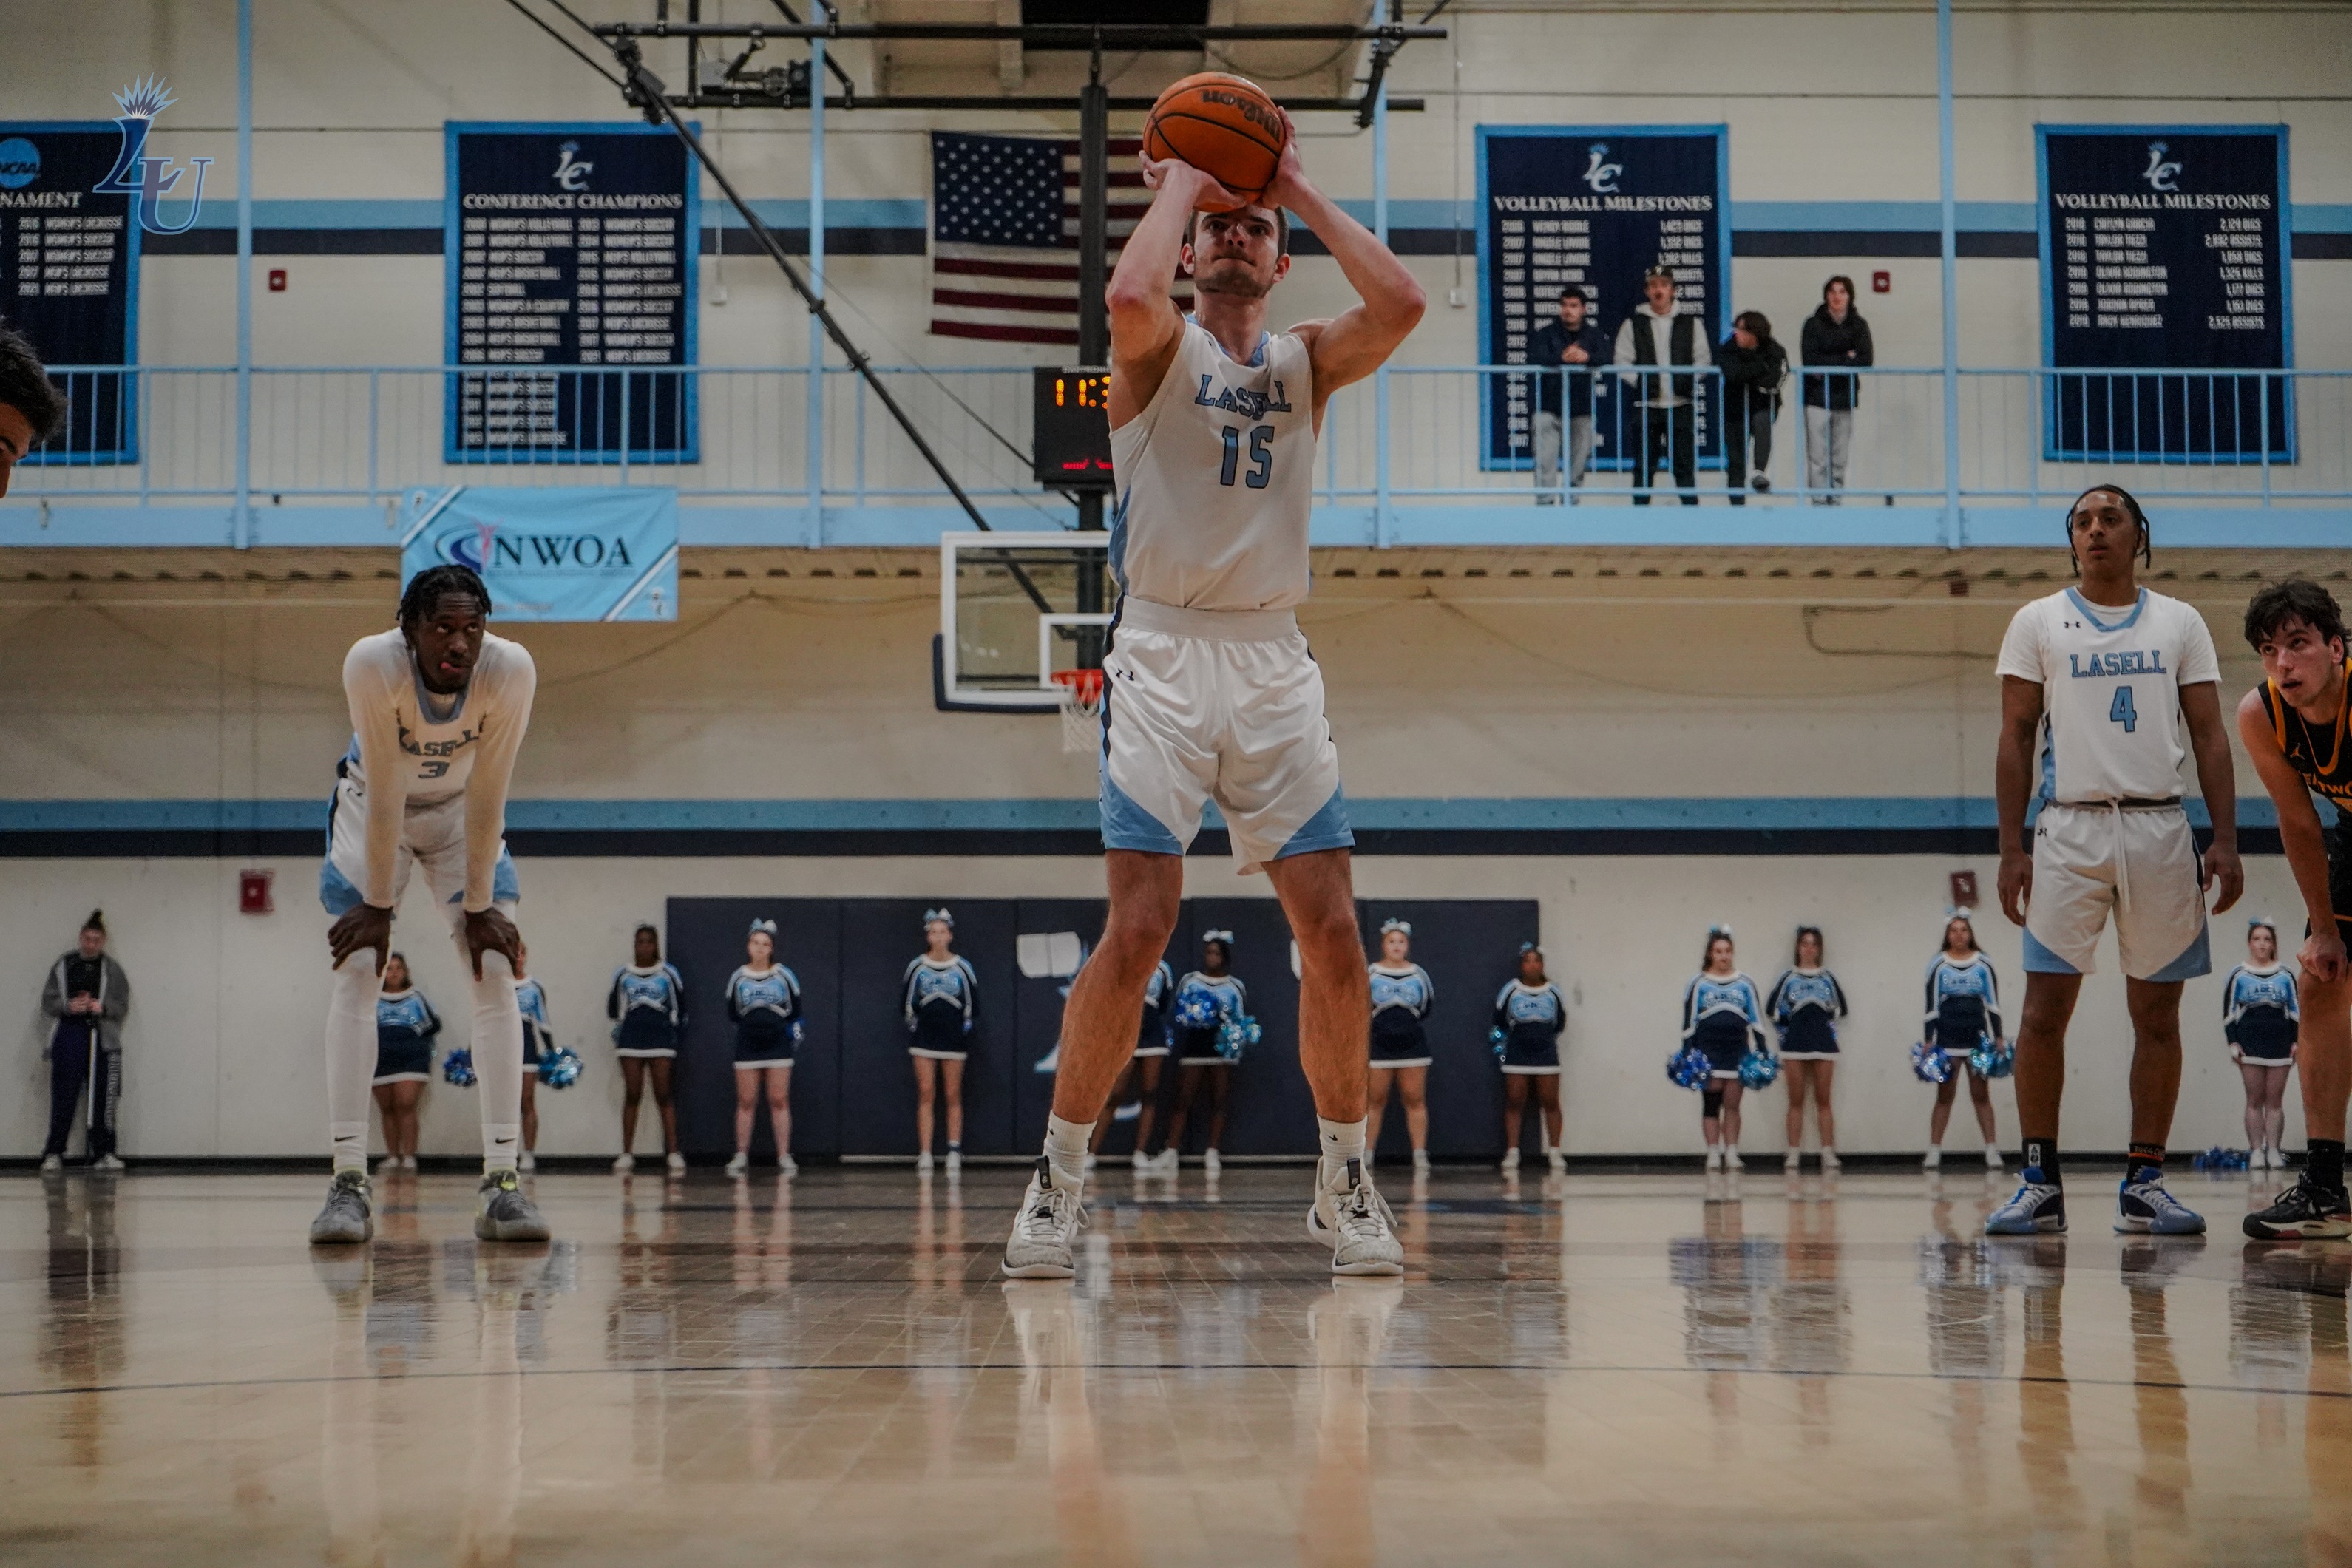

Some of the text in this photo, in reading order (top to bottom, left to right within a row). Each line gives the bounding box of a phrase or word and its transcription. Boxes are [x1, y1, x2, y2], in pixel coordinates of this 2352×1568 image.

[463, 194, 683, 209] CONFERENCE CHAMPIONS
[1494, 195, 1712, 211] VOLLEYBALL MILESTONES
[2056, 194, 2271, 210] VOLLEYBALL MILESTONES
[1195, 374, 1291, 420] LASELL
[1219, 424, 1275, 489] 15
[493, 534, 634, 568] NWOA
[2070, 649, 2167, 678] LASELL
[2109, 685, 2138, 733] 4
[418, 760, 450, 778] 3
